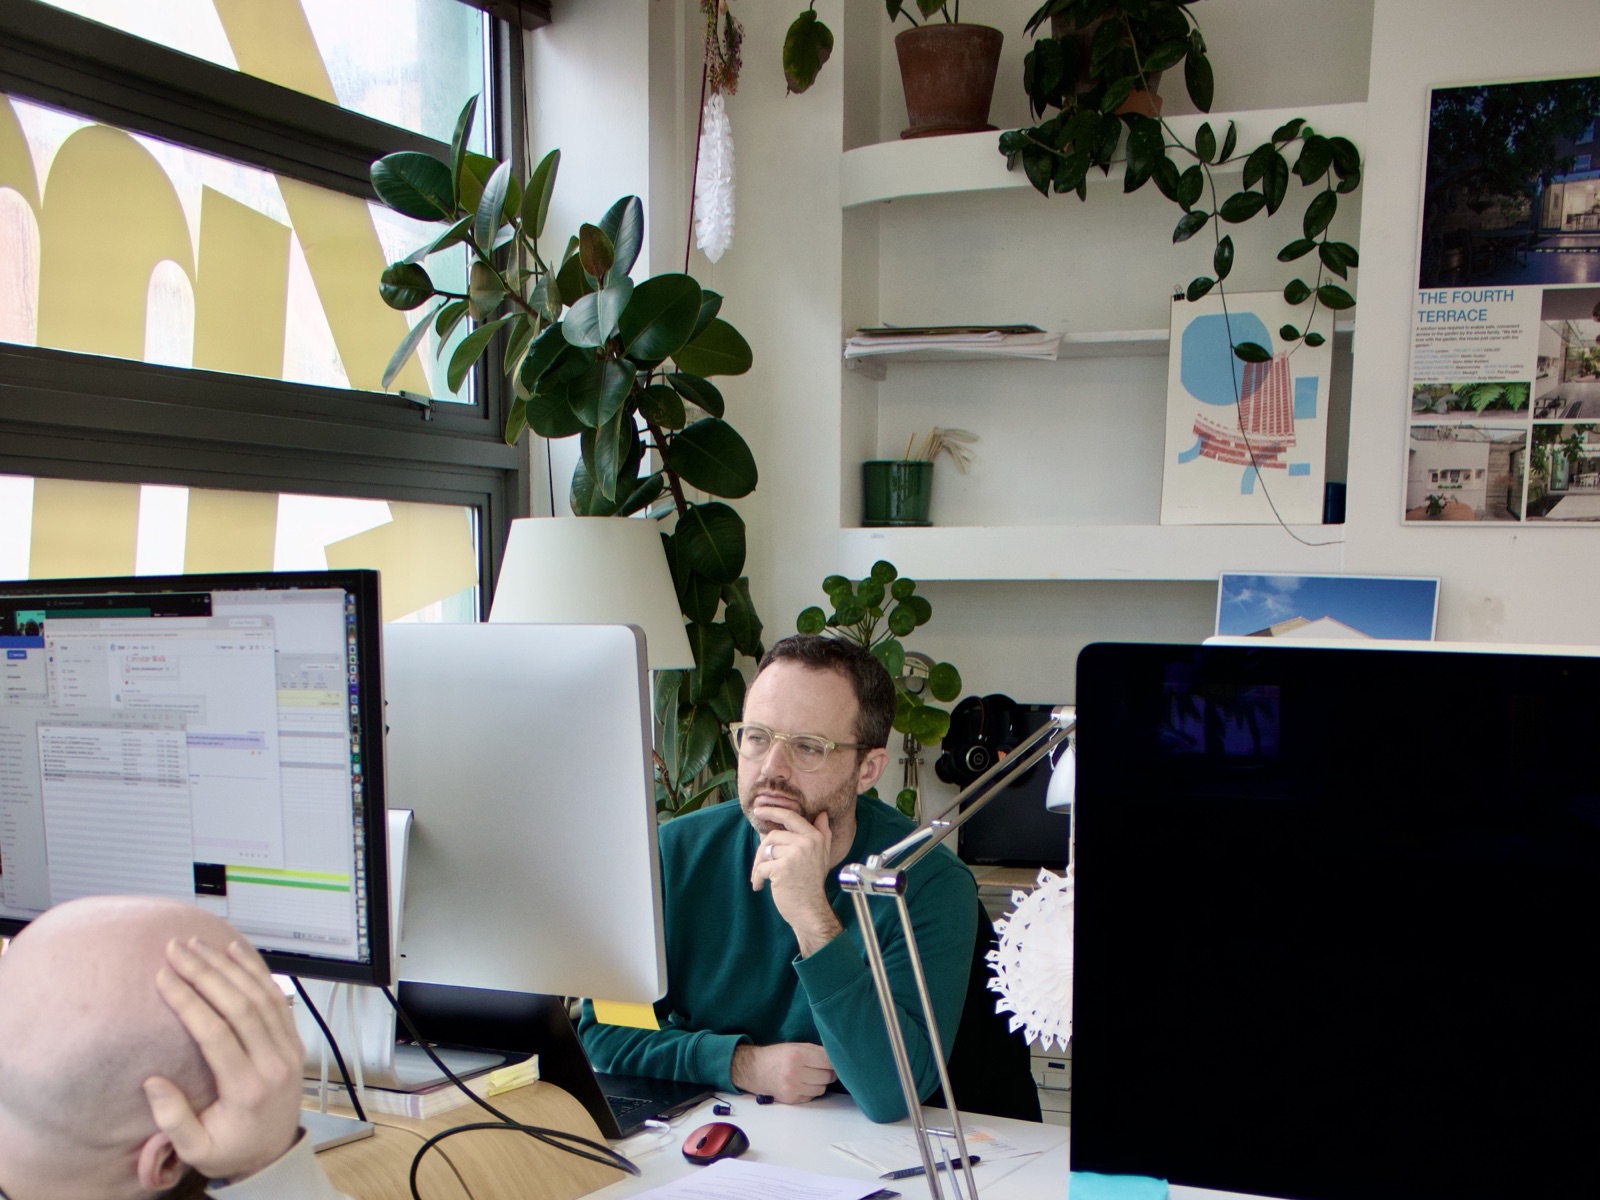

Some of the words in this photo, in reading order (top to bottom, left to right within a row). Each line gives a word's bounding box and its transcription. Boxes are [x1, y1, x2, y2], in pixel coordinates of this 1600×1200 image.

[1418, 291, 1448, 304] THE
[1452, 289, 1514, 303] FOURTH
[1417, 308, 1488, 322] TERRACE
